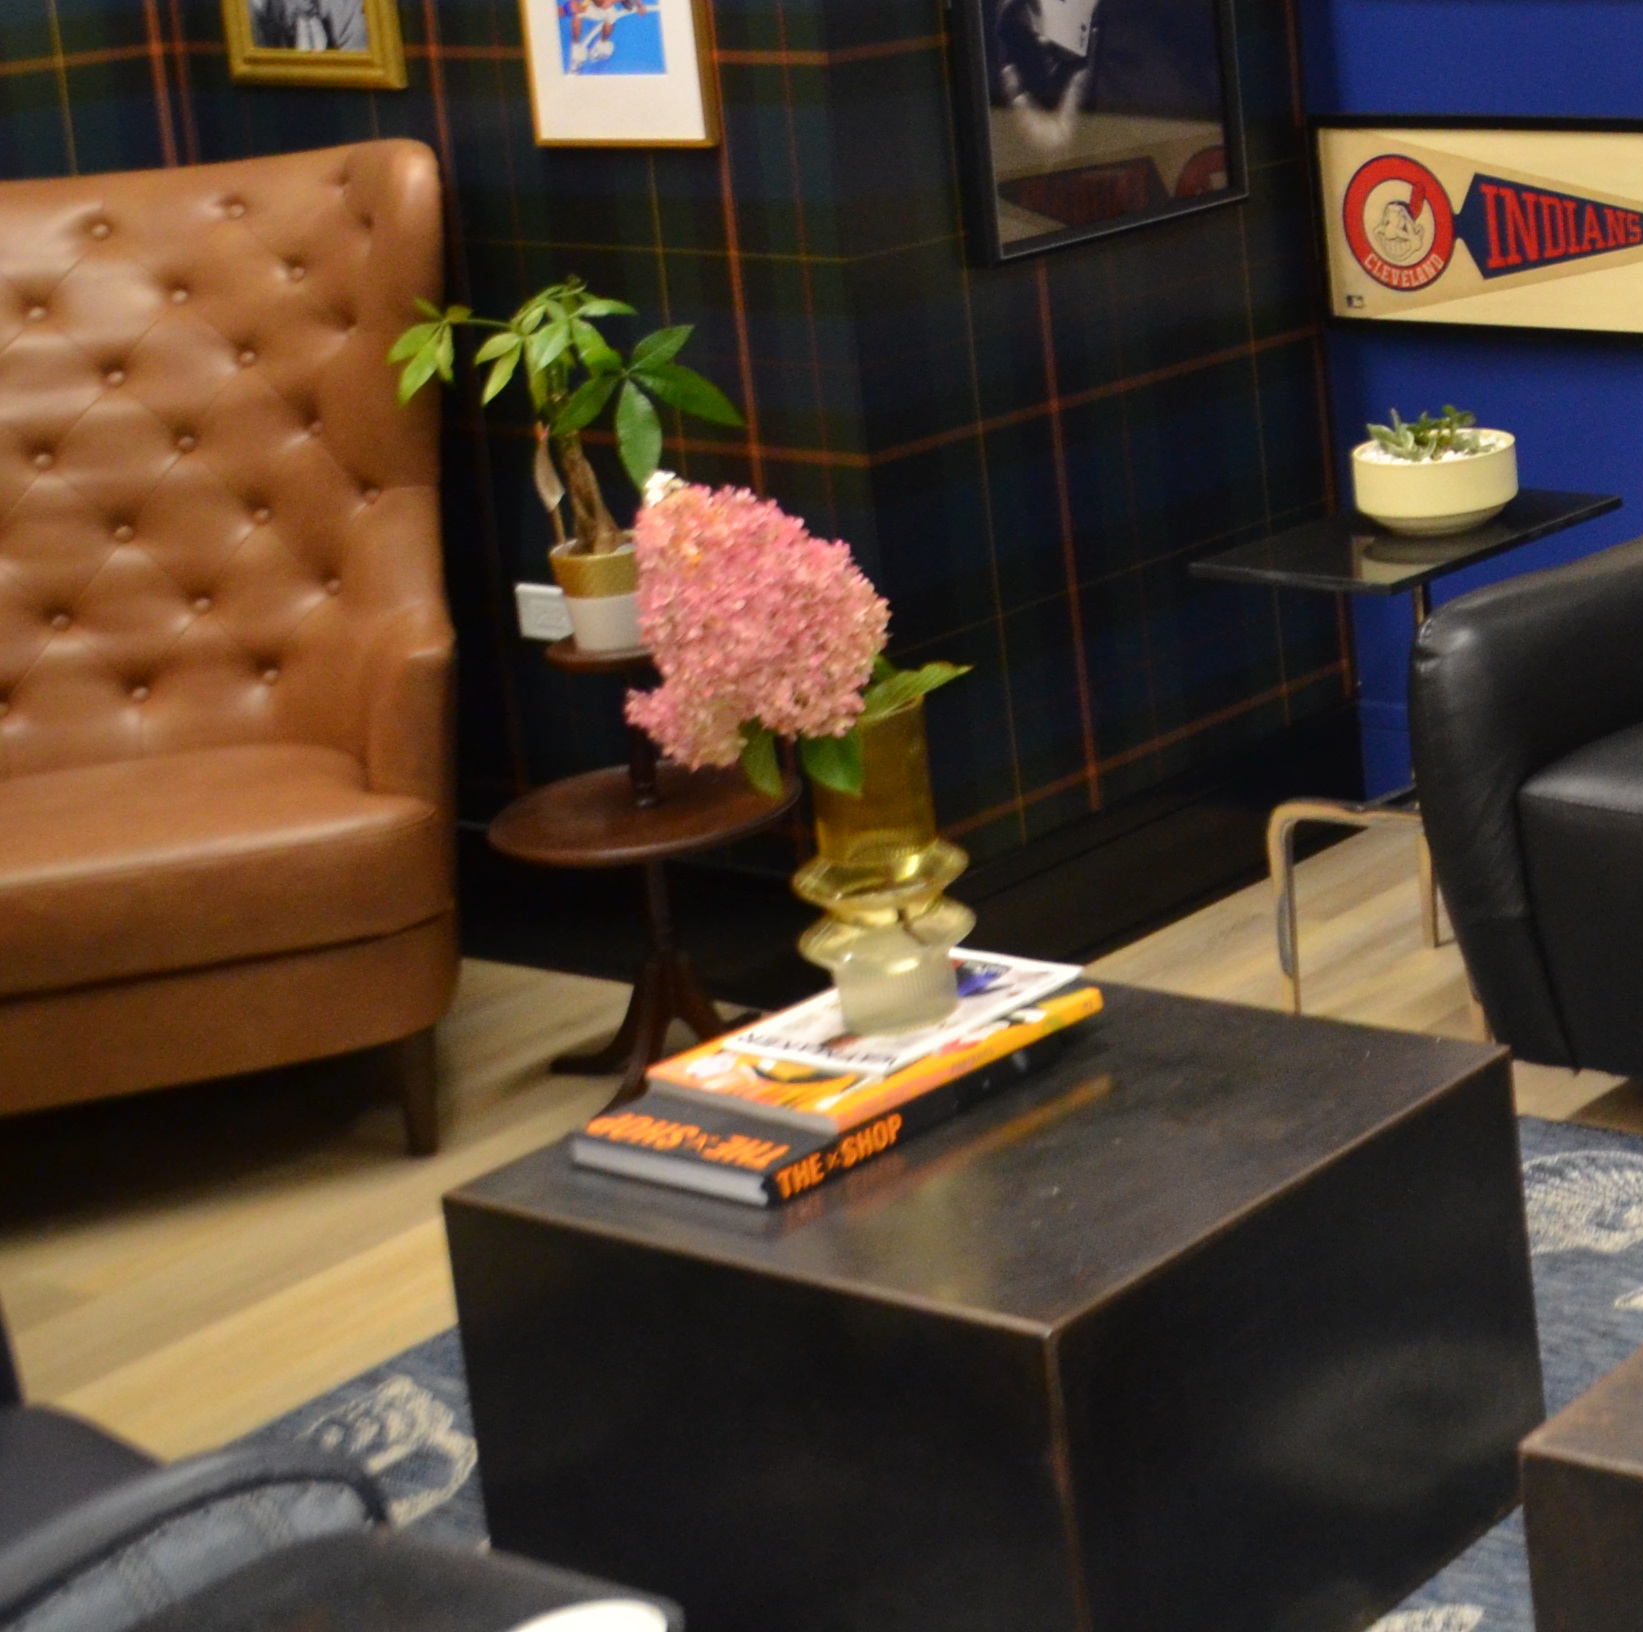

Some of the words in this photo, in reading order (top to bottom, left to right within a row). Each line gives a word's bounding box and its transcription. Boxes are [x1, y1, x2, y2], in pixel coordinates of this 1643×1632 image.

[1479, 183, 1643, 268] INDIANS
[1364, 252, 1445, 289] CLEVELAND
[775, 1152, 824, 1200] THE
[839, 1113, 902, 1167] SHOP
